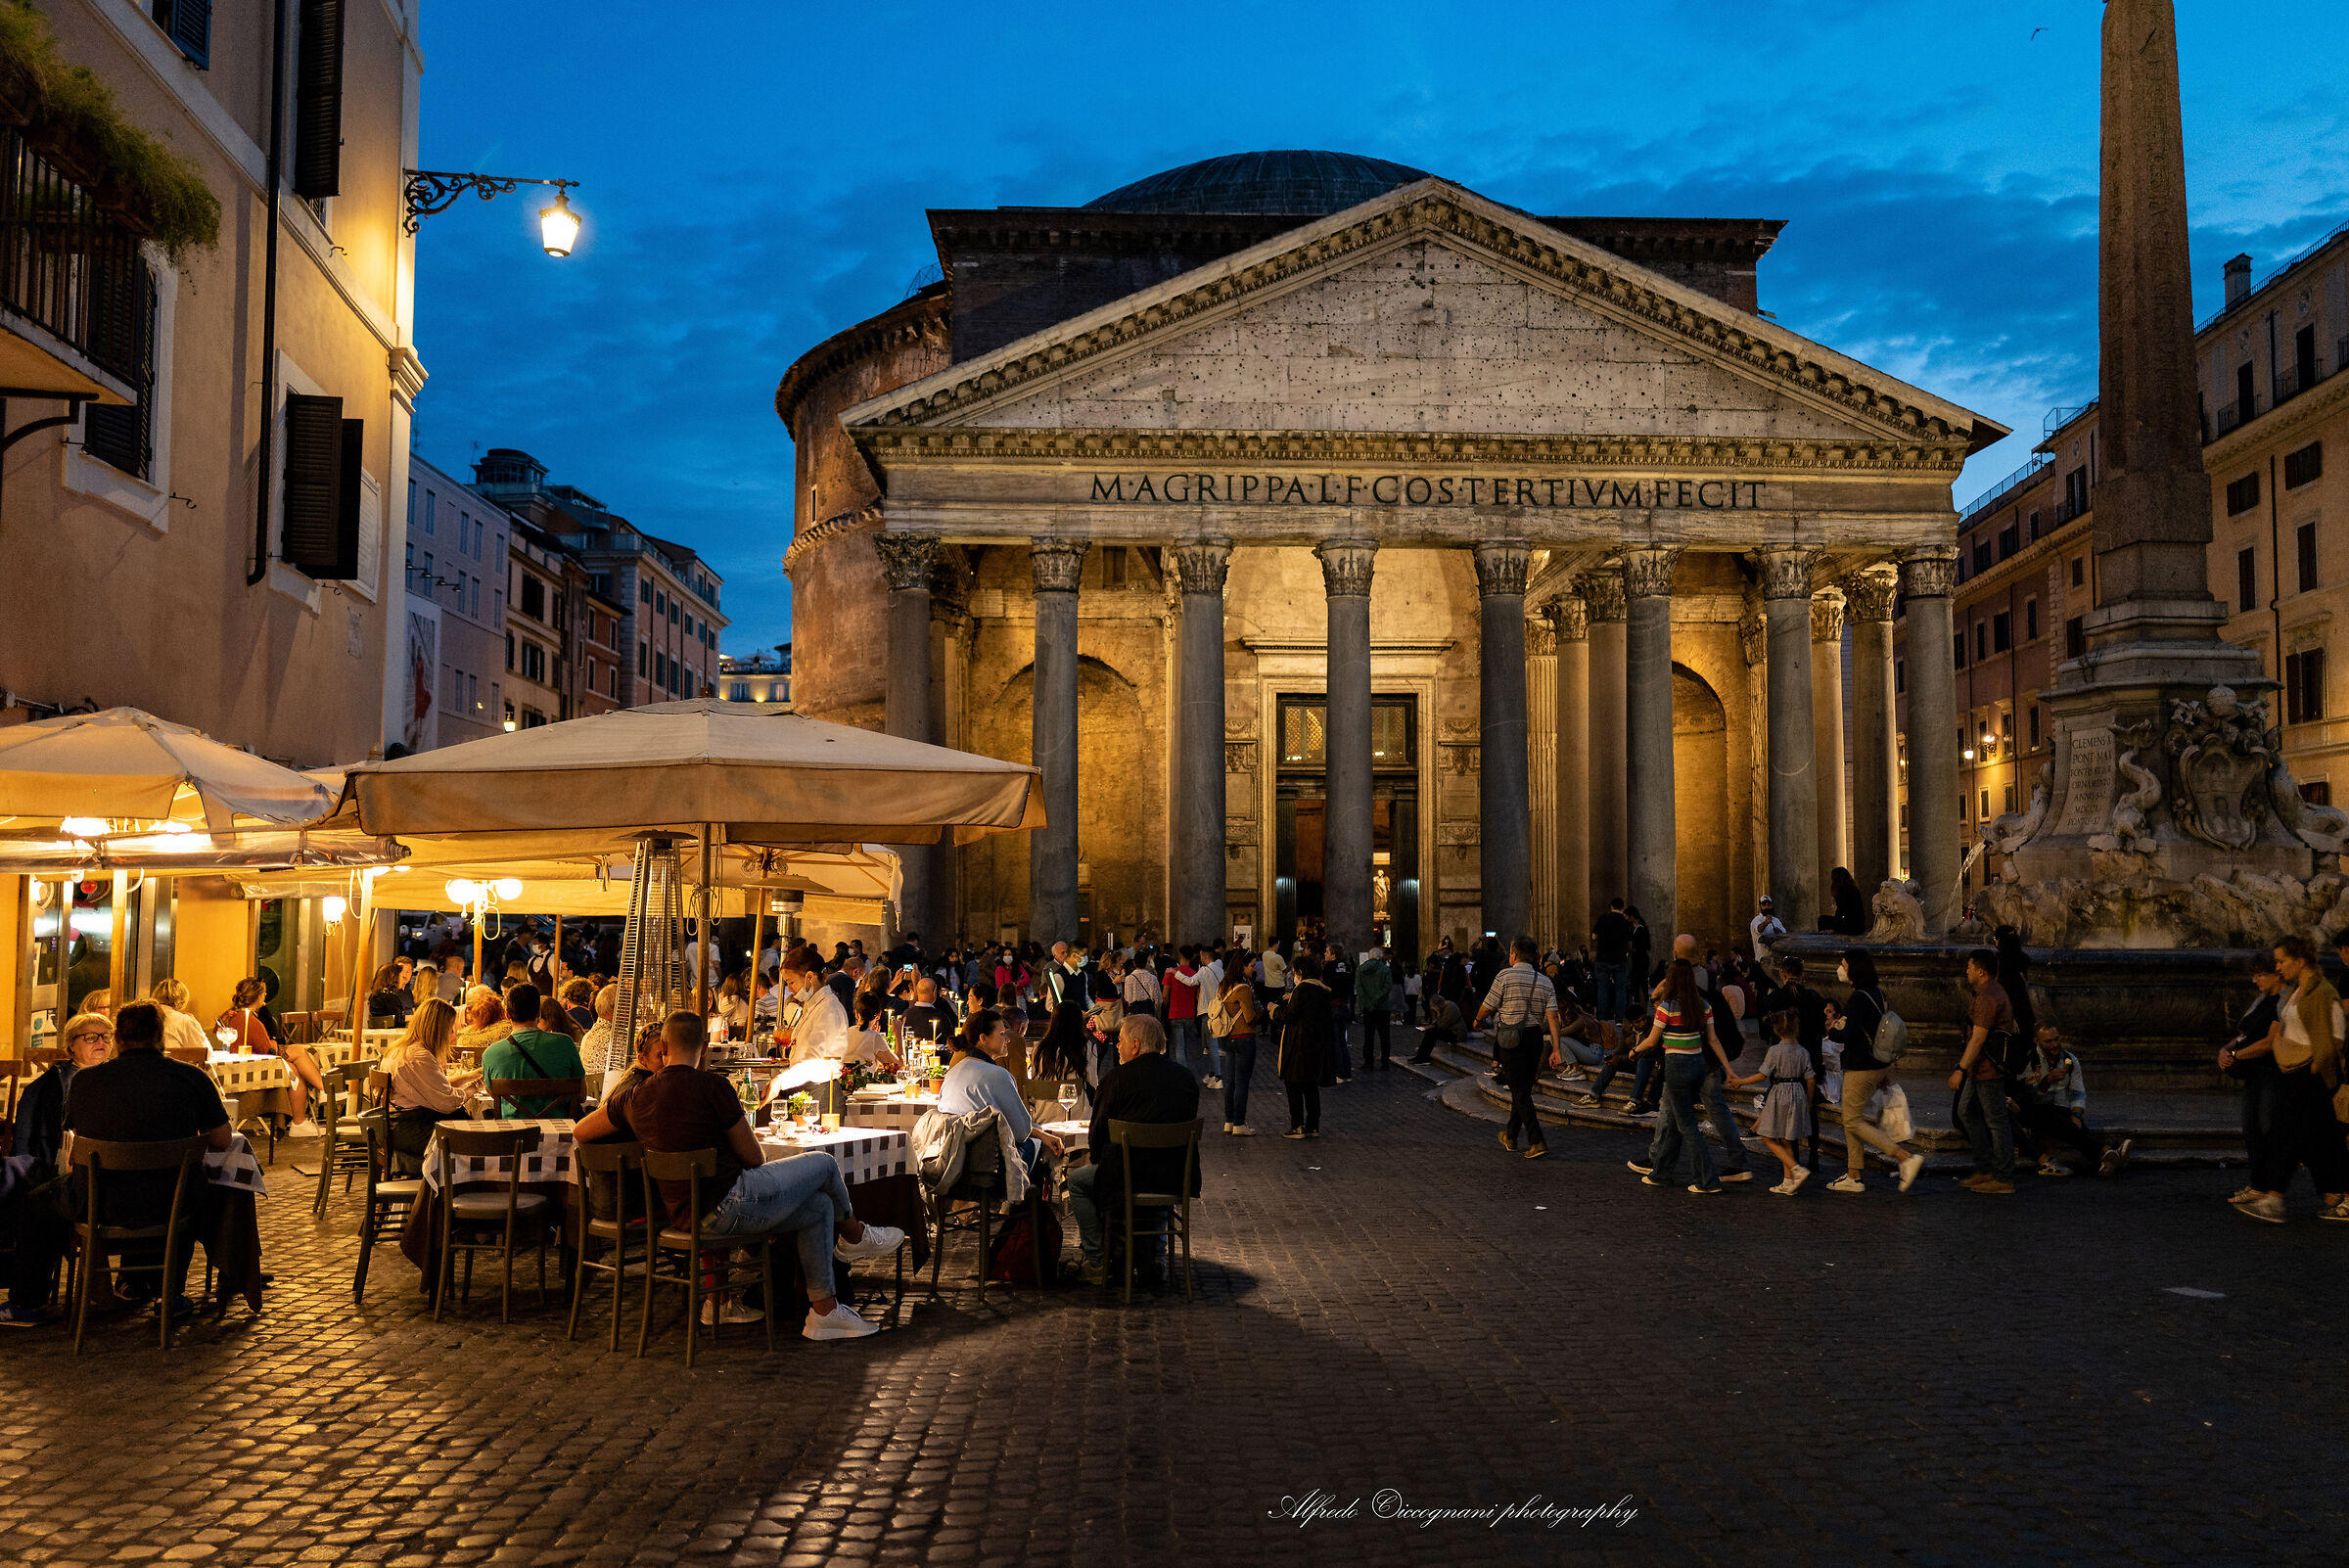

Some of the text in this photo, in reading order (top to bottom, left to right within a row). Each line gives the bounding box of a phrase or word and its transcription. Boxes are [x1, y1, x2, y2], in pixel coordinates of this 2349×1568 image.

[1132, 474, 1309, 504] AGRIPPA
[1372, 475, 1454, 505] COS
[1462, 478, 1642, 508] TERTIVM
[1654, 480, 1767, 509] FECIT
